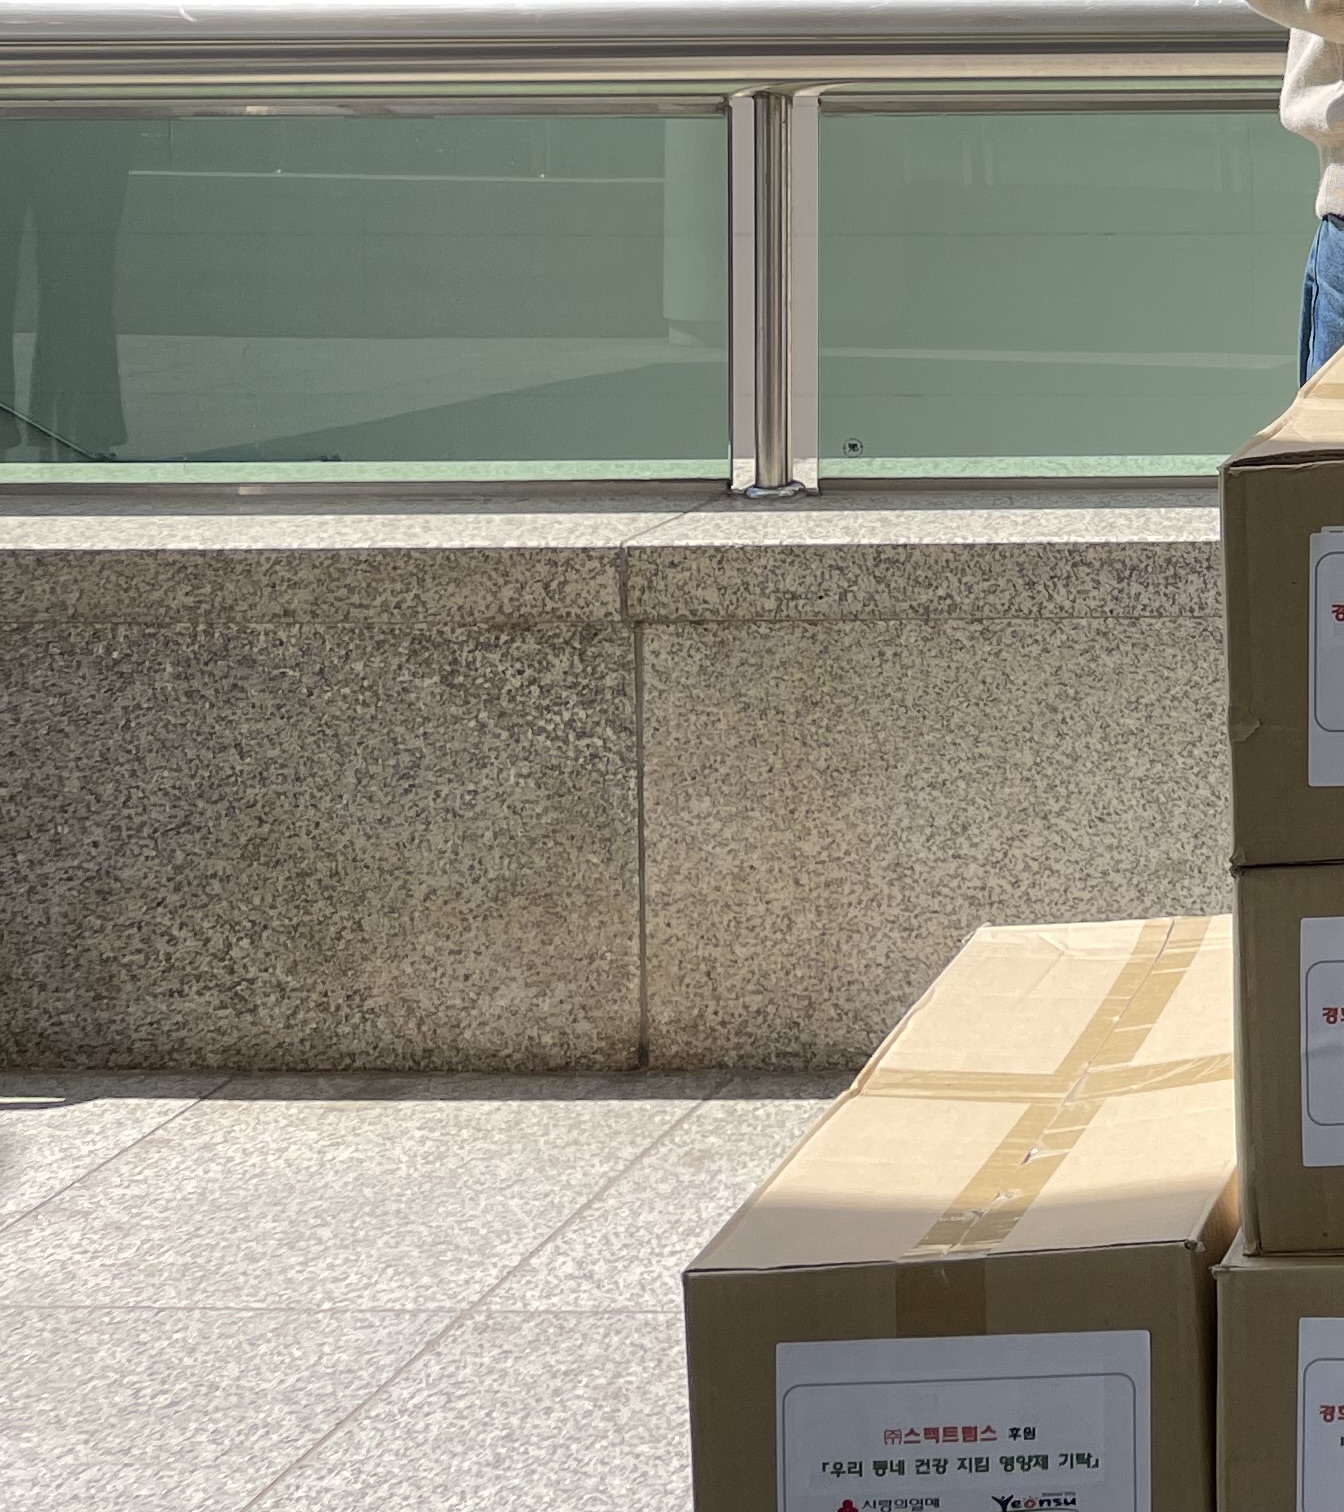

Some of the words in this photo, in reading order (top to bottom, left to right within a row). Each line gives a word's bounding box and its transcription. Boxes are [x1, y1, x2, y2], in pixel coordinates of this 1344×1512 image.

[1008, 1426, 1037, 1441] 후원
[872, 1459, 905, 1477] 동네
[914, 1457, 949, 1475] 건강
[956, 1456, 990, 1473] 지킴
[998, 1454, 1049, 1473] 영양제
[990, 1492, 1078, 1512] Yeonsu
